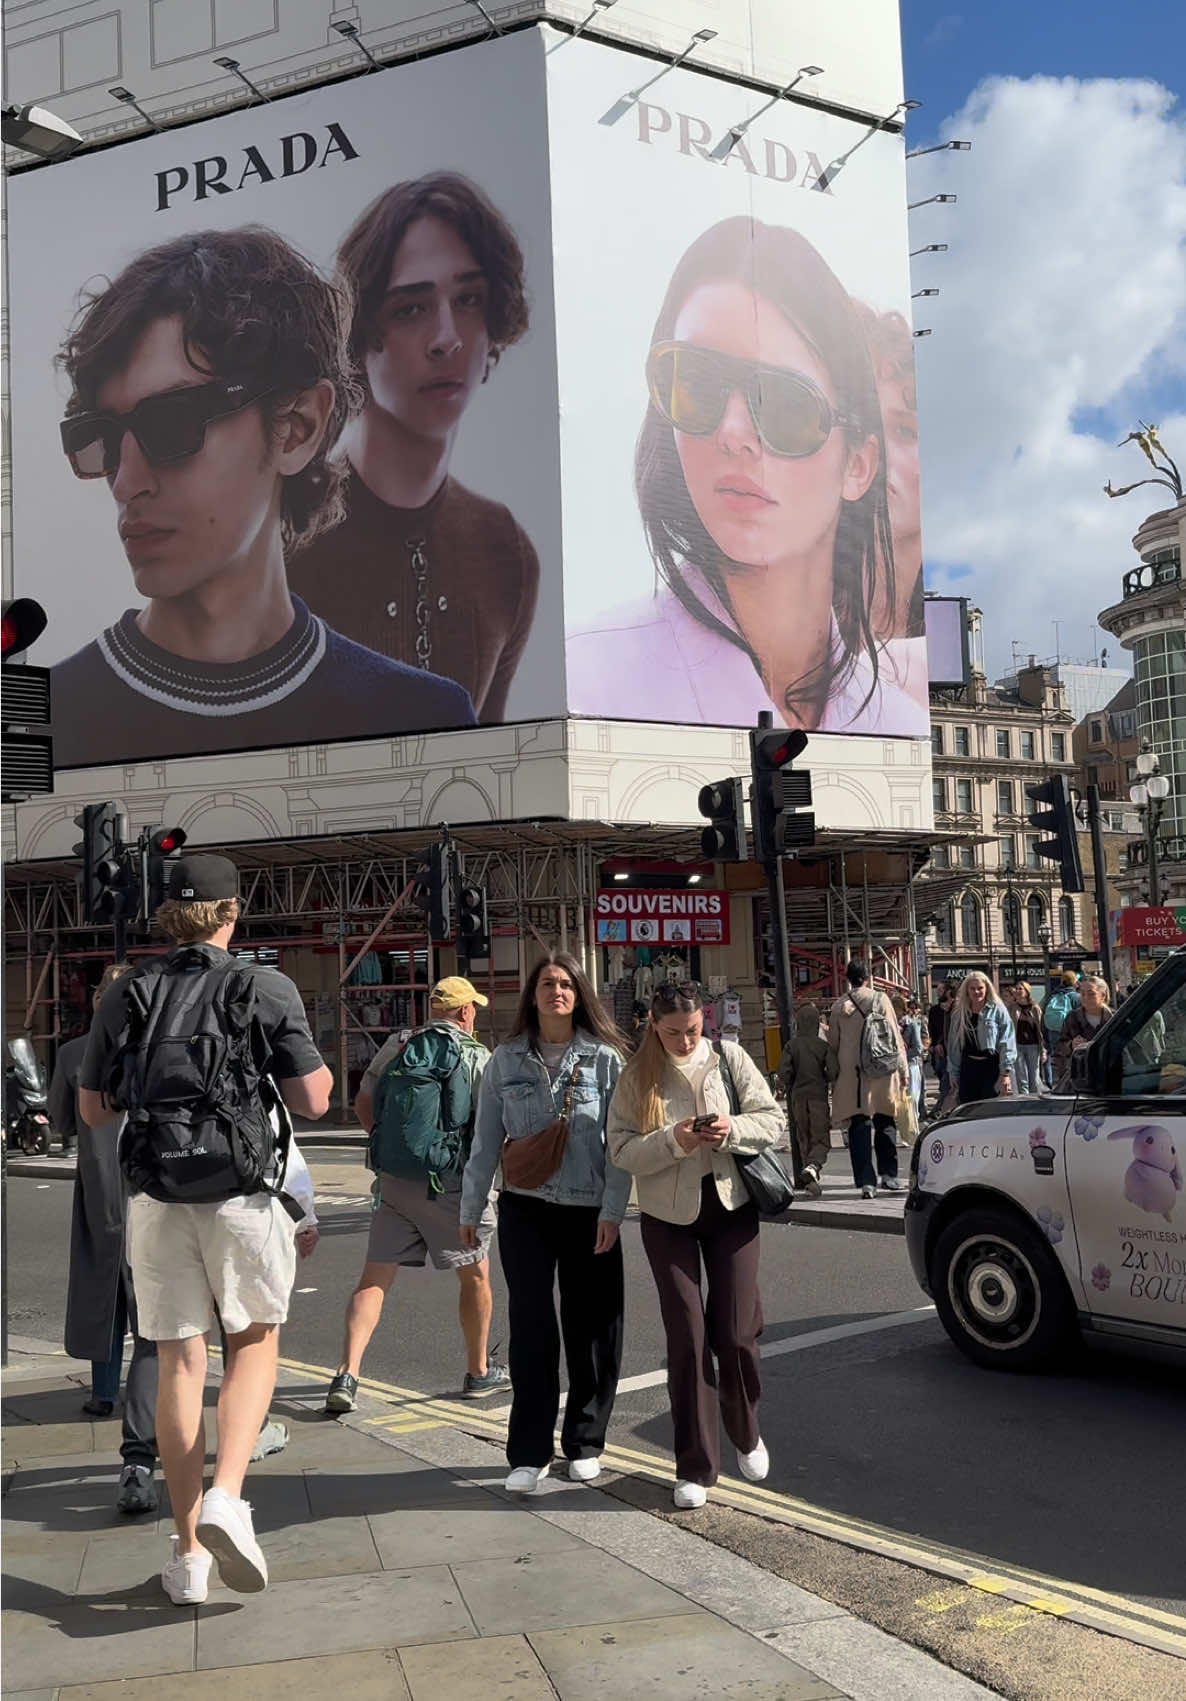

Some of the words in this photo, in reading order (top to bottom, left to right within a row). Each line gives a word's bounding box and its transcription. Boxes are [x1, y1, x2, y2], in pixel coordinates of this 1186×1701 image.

[637, 101, 835, 196] PRADA
[154, 122, 360, 212] PRADA
[597, 894, 721, 914] SOUVENIRS
[1145, 916, 1168, 926] BUY
[1136, 928, 1183, 936] TICKETS
[948, 1145, 1019, 1160] TATCHA
[1118, 1226, 1178, 1244] WEIGHTLESS
[1120, 1241, 1149, 1271] 2x
[1130, 1273, 1186, 1305] BOU
